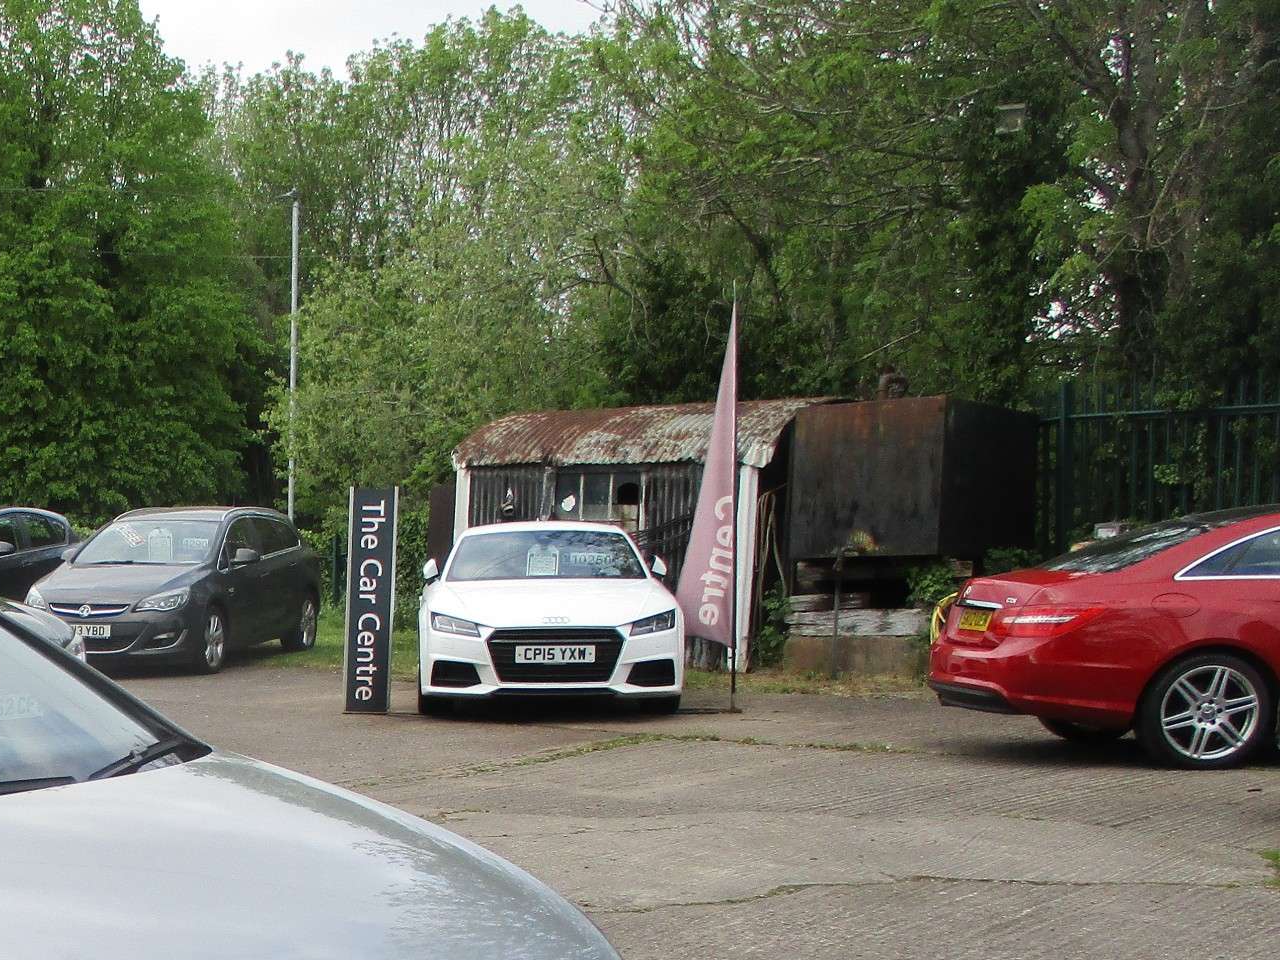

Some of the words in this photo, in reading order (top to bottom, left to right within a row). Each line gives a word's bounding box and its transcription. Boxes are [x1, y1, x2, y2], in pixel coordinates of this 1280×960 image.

[360, 500, 386, 550] The
[359, 558, 383, 605] Car
[85, 626, 105, 636] YBD
[524, 648, 555, 660] CP15
[560, 648, 587, 660] YXW
[355, 612, 381, 701] Centre
